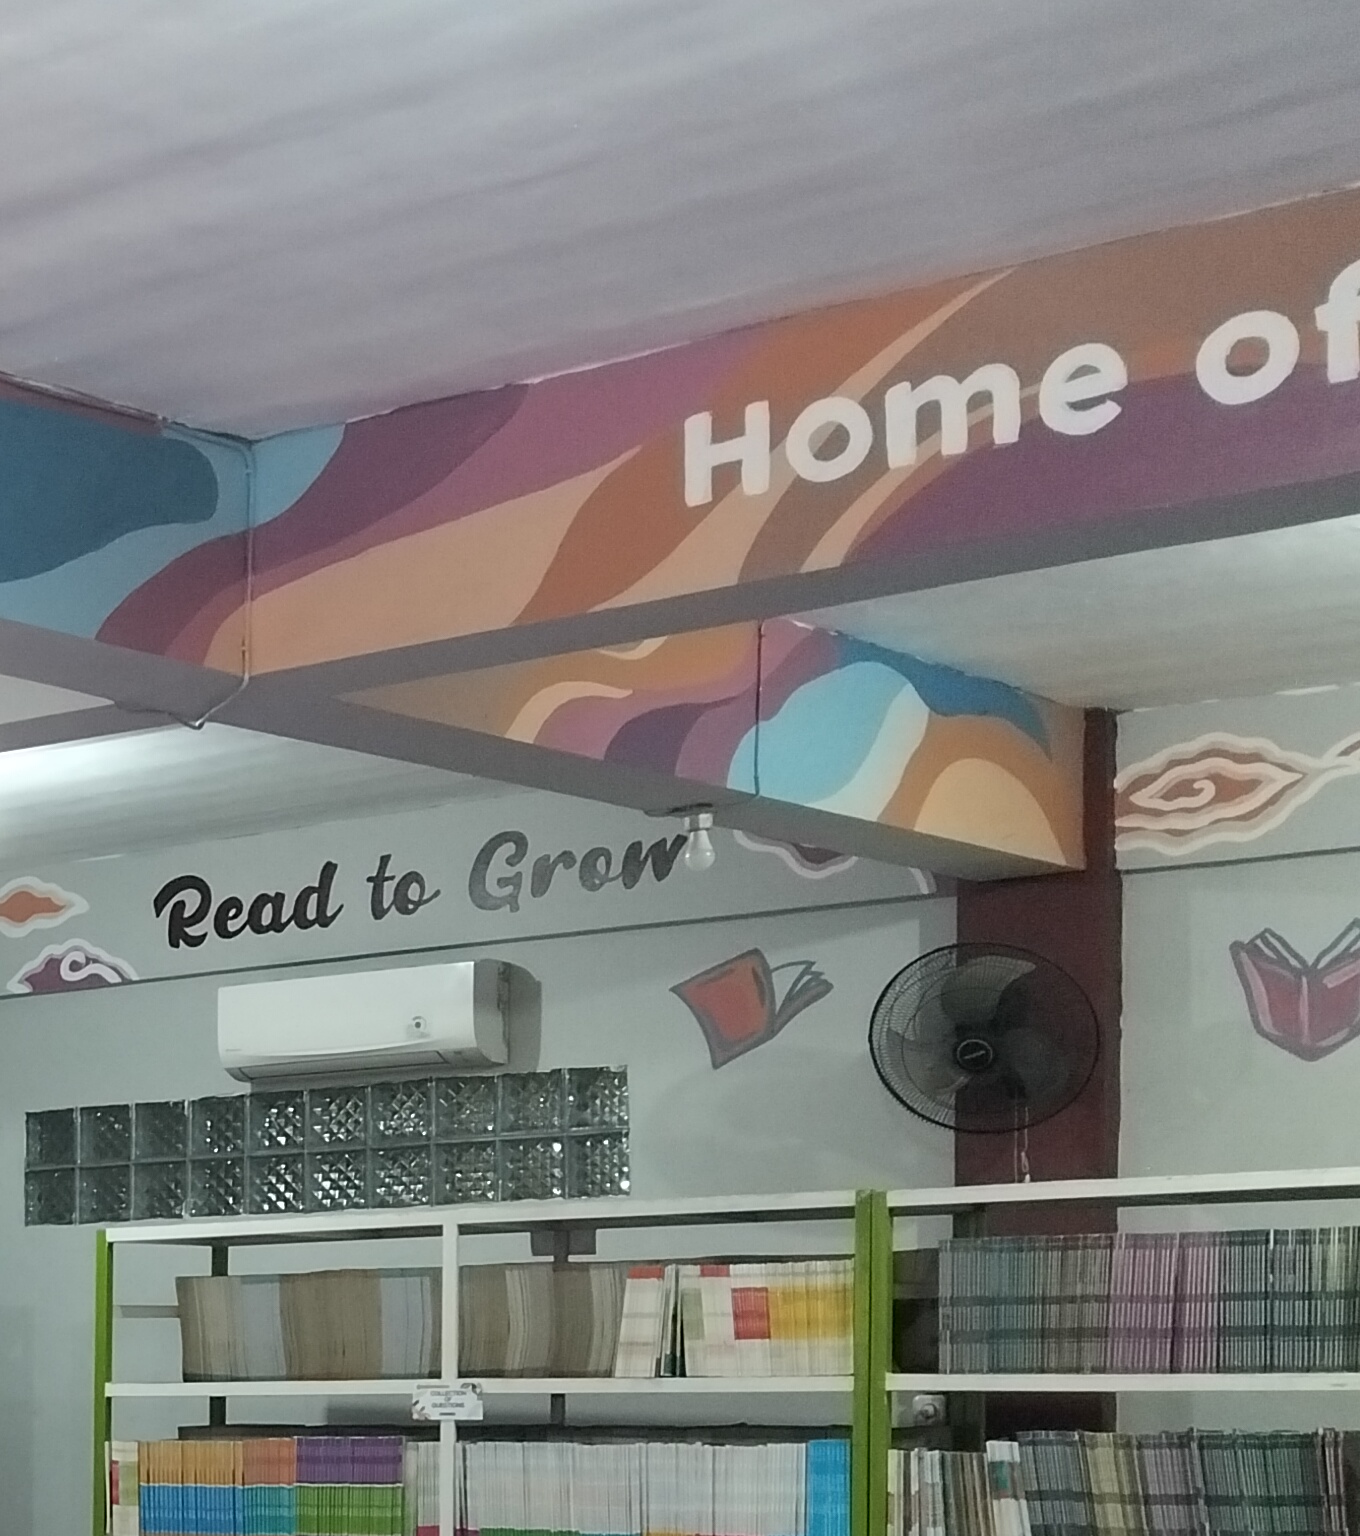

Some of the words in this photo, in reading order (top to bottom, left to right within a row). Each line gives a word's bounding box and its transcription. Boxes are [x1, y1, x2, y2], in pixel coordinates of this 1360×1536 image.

[683, 342, 1129, 508] Home
[1194, 258, 1360, 406] of
[153, 860, 344, 949] Read
[367, 852, 441, 921] to
[467, 829, 689, 913] Grow
